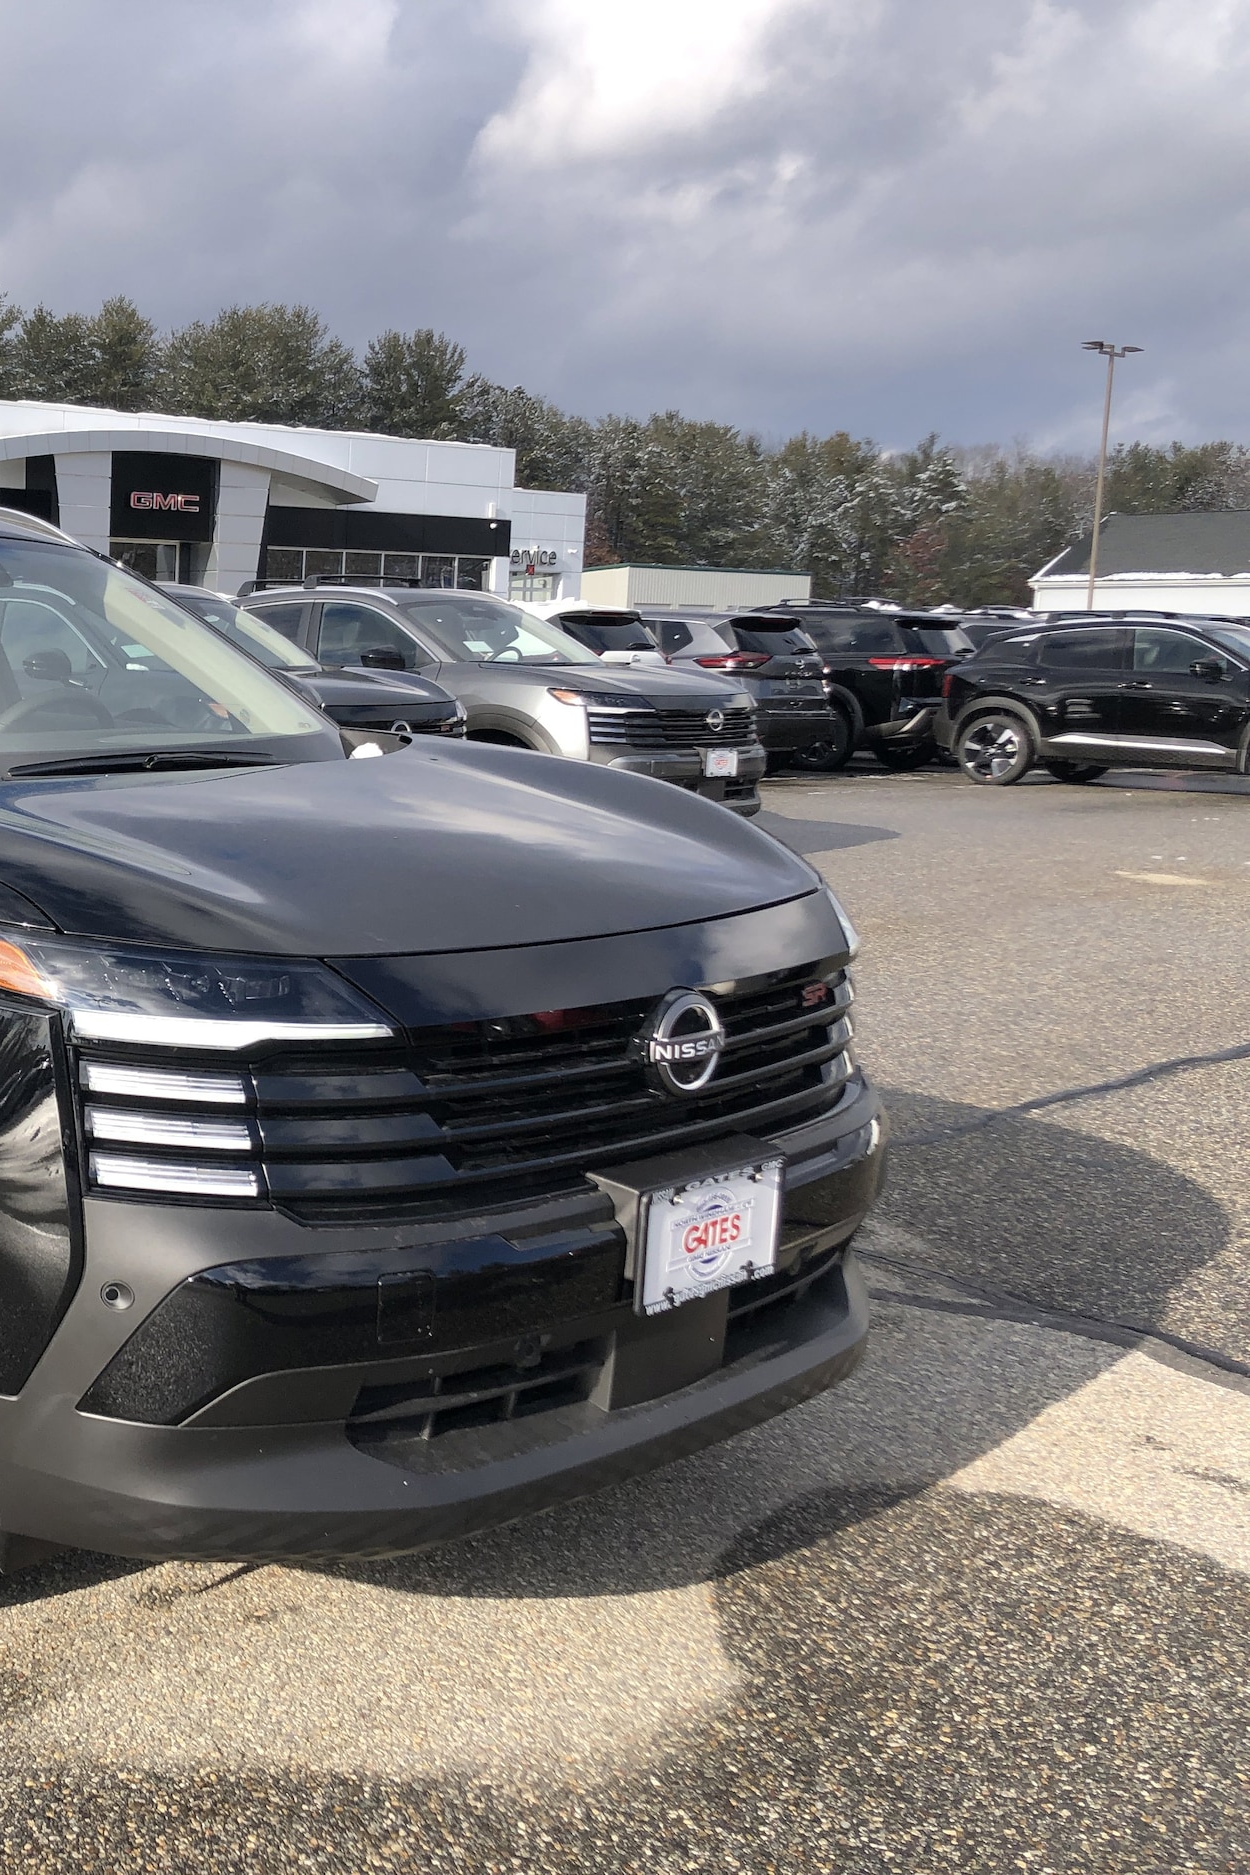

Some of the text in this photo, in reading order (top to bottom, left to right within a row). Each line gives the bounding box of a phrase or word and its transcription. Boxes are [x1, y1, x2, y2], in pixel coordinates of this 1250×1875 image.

[130, 491, 199, 512] GMC
[511, 545, 557, 566] ervice
[654, 1034, 724, 1061] NISSAN
[685, 1166, 754, 1191] GATES
[683, 1213, 741, 1254] GATES
